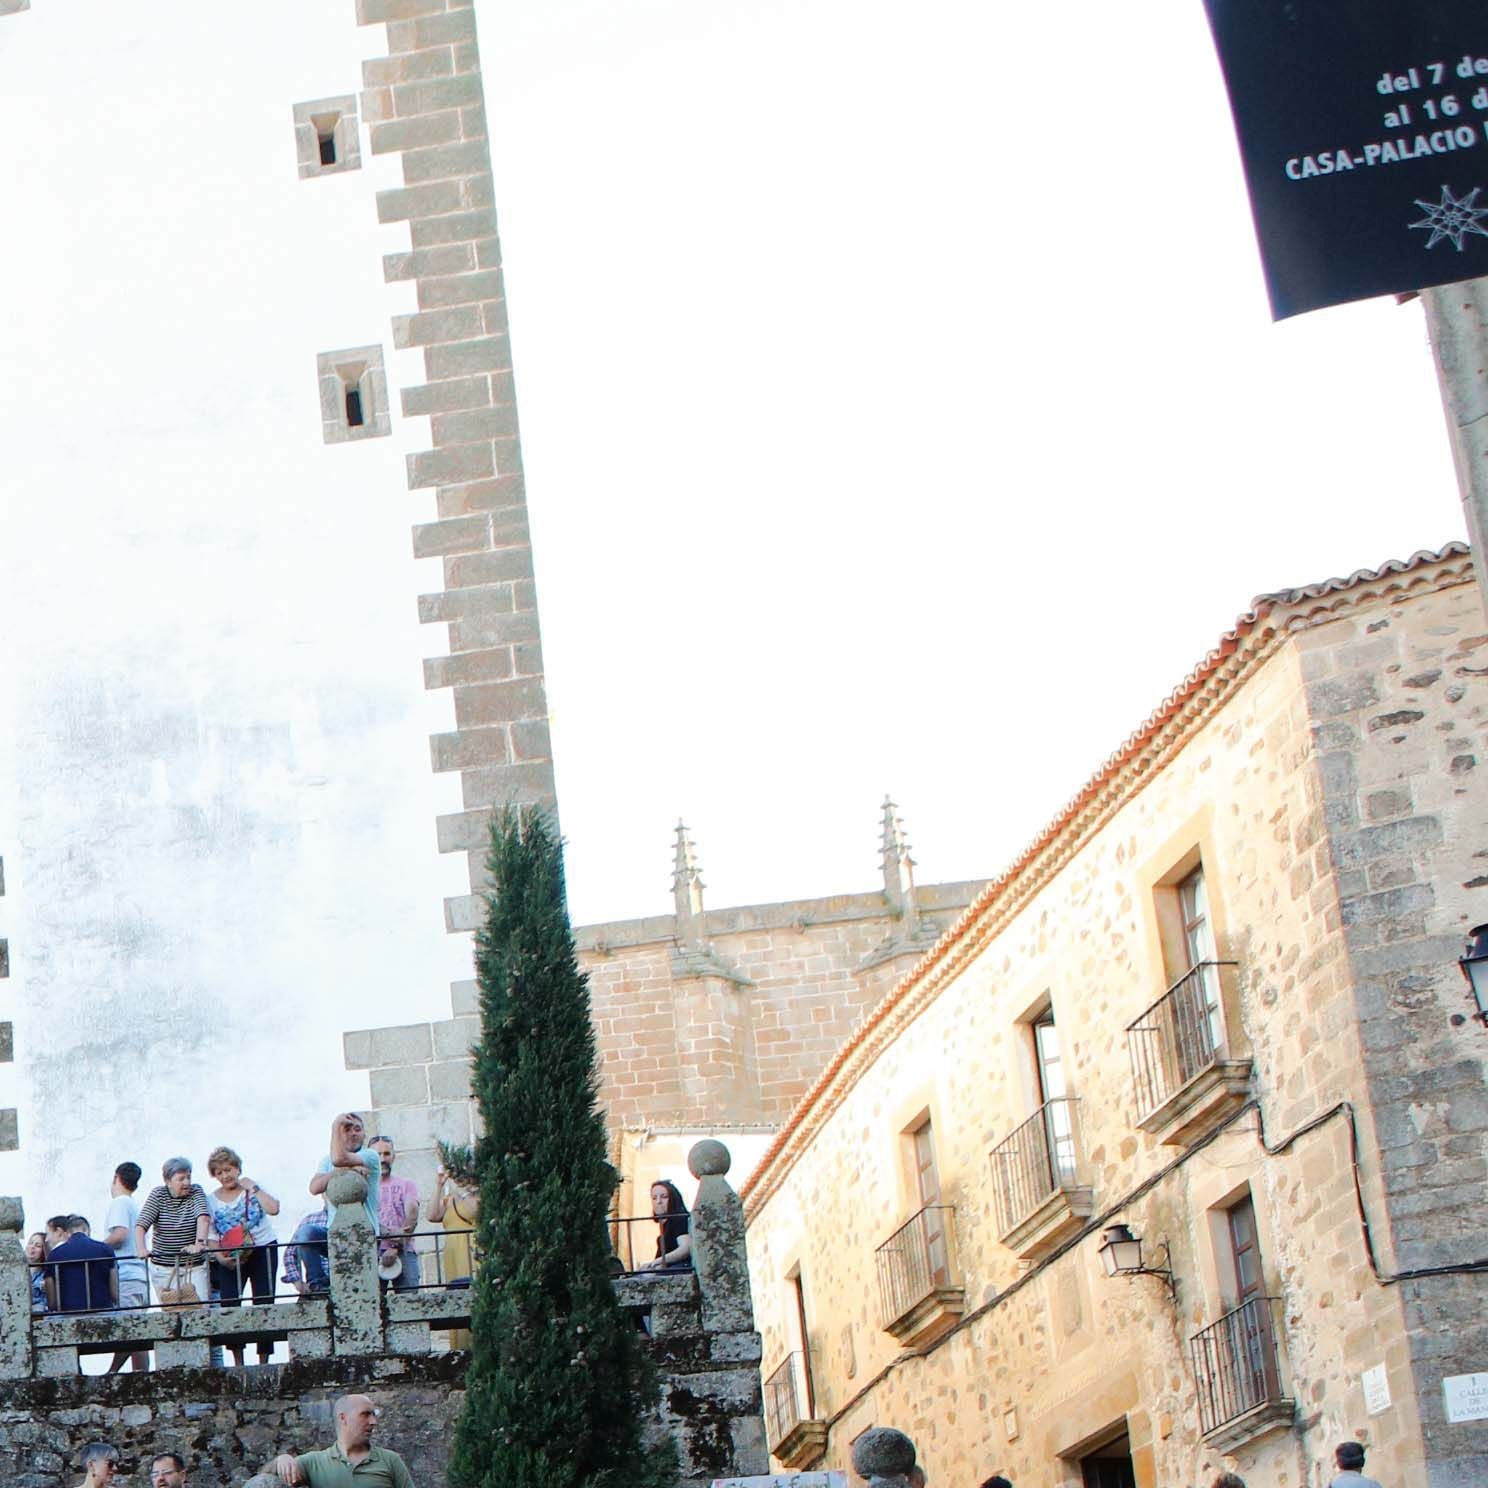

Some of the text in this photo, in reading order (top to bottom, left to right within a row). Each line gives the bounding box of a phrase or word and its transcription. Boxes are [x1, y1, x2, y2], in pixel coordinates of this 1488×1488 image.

[1376, 68, 1421, 95] del
[1426, 62, 1444, 85] 7
[1384, 103, 1411, 128] al
[1423, 94, 1460, 120] 16
[1284, 125, 1476, 181] CASA-PALACIO
